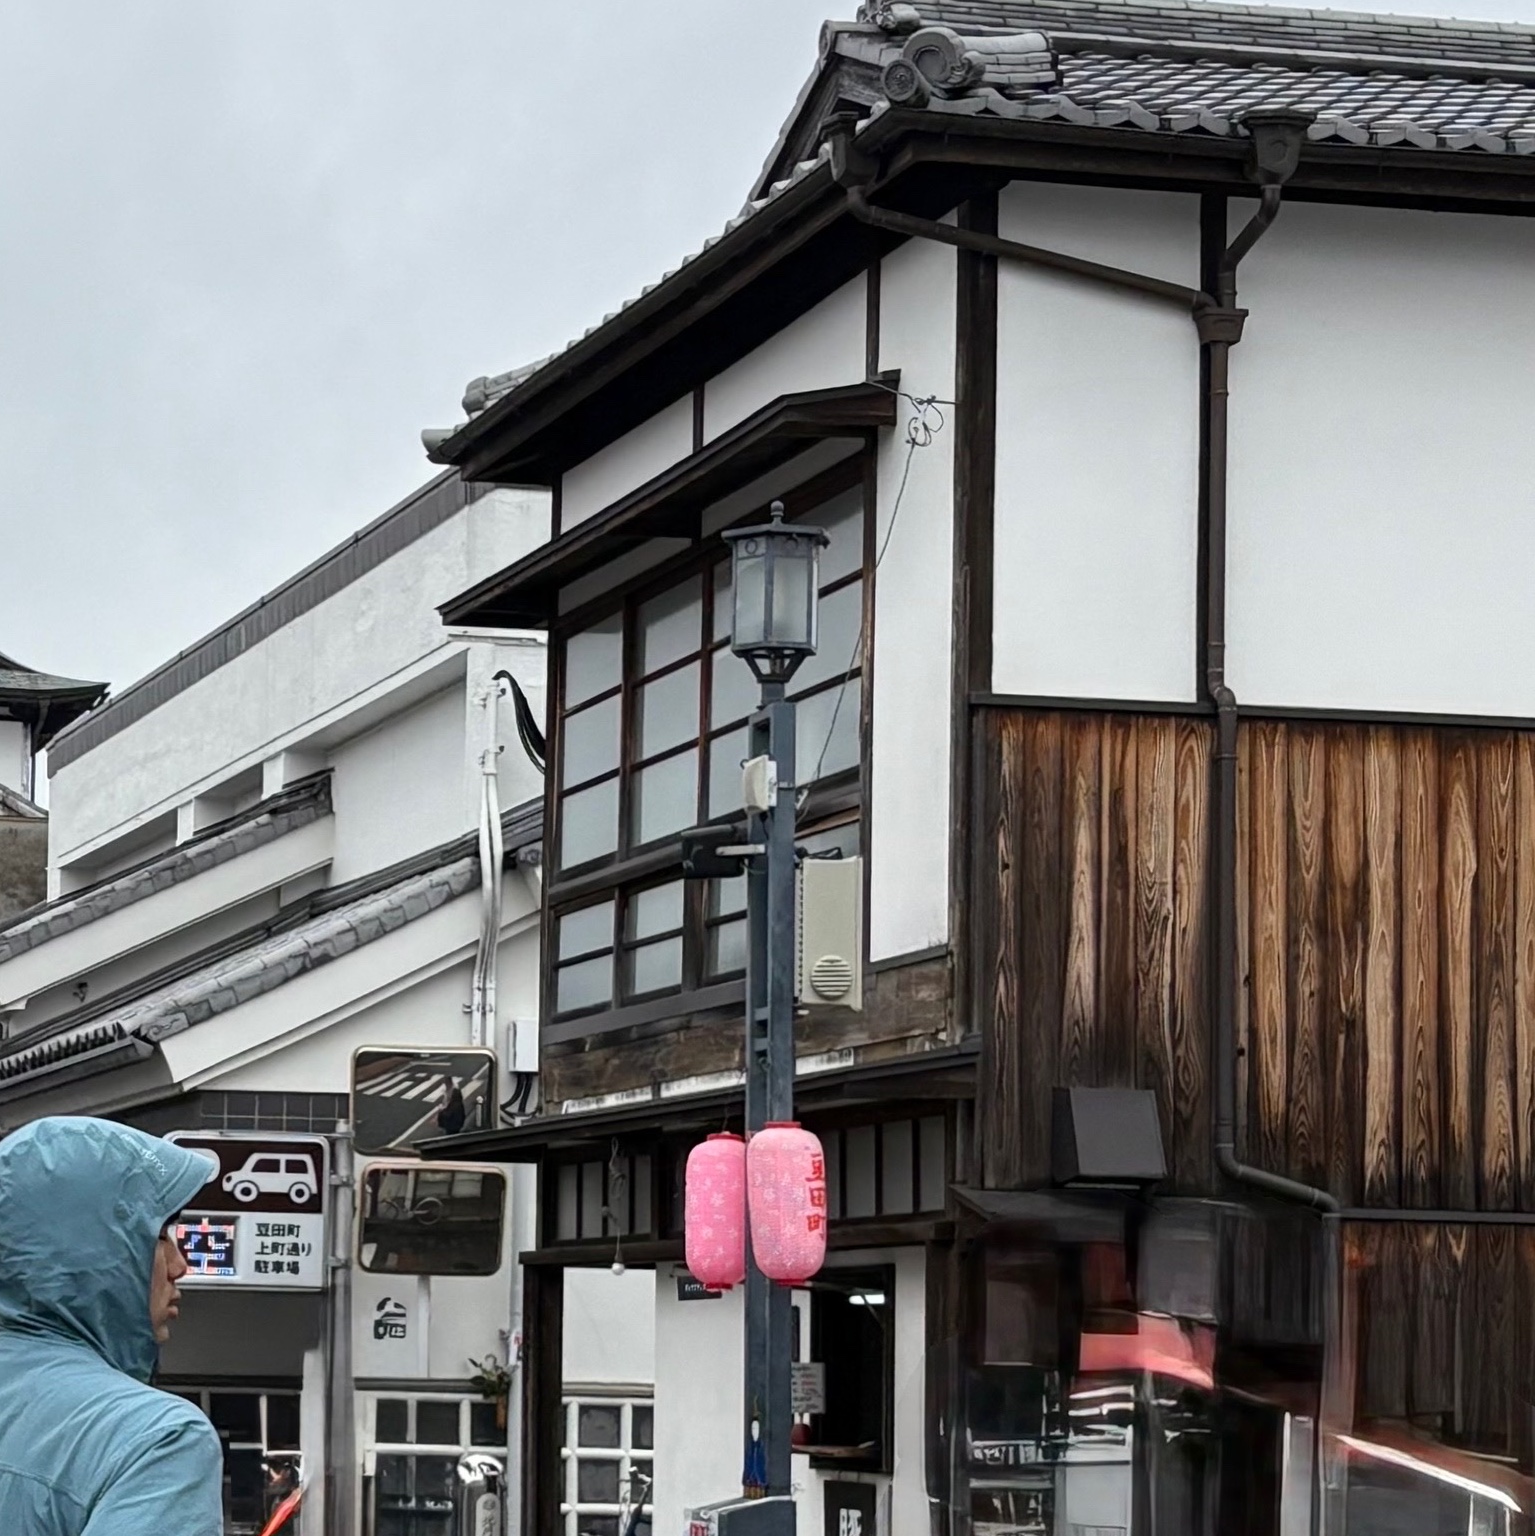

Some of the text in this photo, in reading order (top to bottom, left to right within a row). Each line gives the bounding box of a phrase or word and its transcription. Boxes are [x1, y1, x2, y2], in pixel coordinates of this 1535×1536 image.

[255, 1222, 301, 1238] 豆田町
[255, 1241, 312, 1257] 上町通り
[254, 1260, 300, 1275] 駐車場
